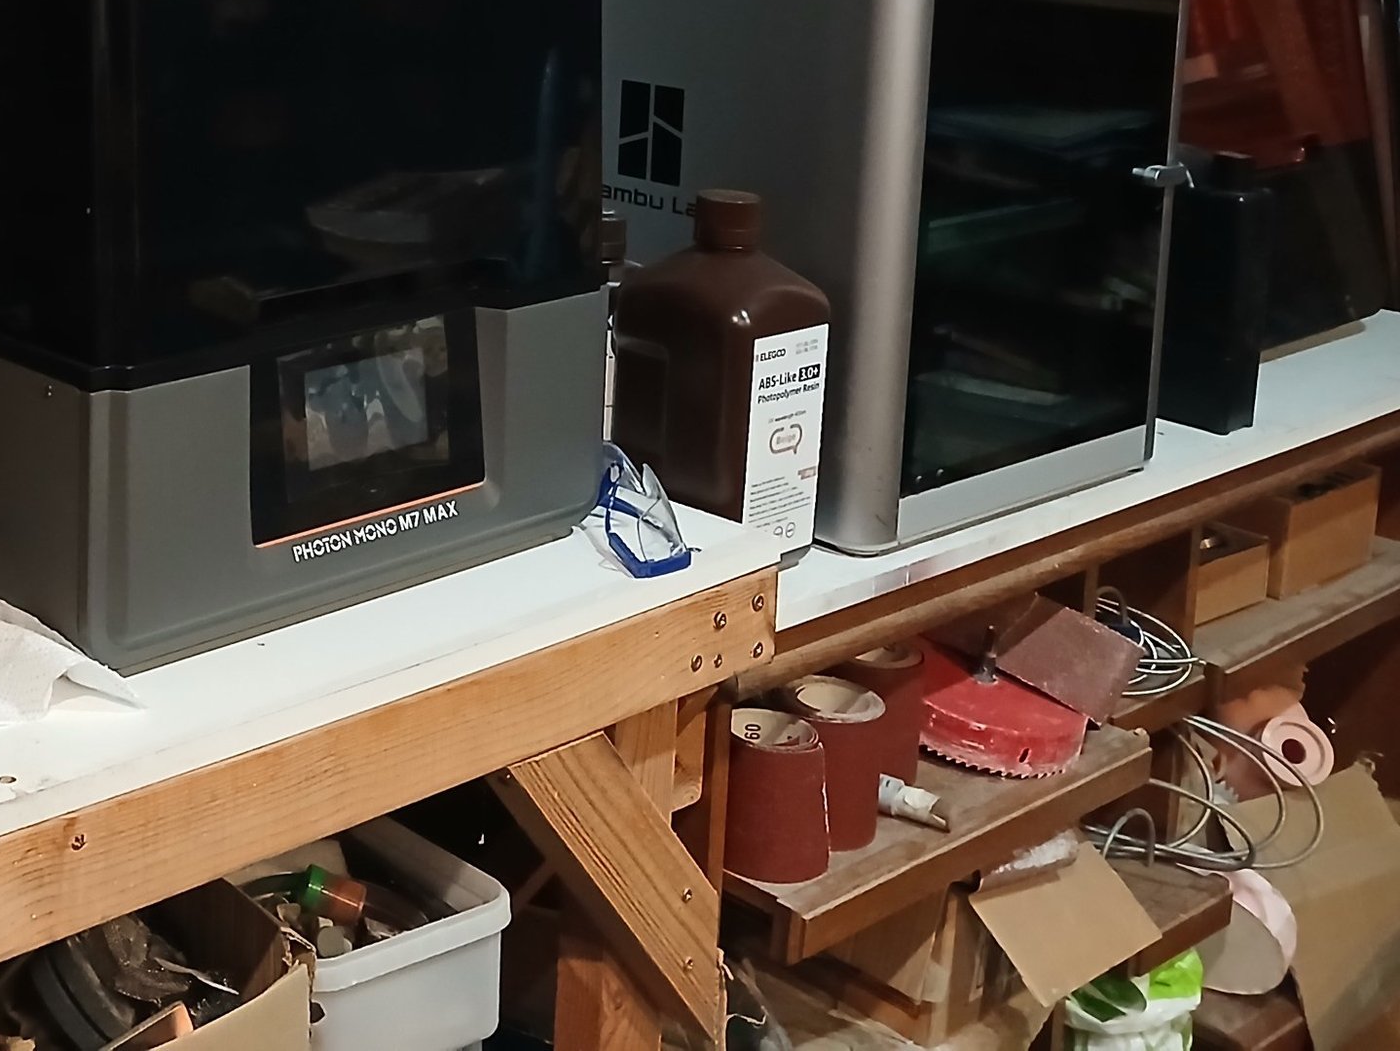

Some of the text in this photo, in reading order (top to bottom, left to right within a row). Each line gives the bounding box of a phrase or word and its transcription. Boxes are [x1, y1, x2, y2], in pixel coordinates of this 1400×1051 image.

[602, 183, 664, 211] ambu
[760, 348, 787, 362] ELEGOO
[757, 381, 820, 404] Photopolymer Resin
[758, 371, 797, 391] ABS-Like
[292, 500, 459, 563] PHOTON MONO M7 MAX
